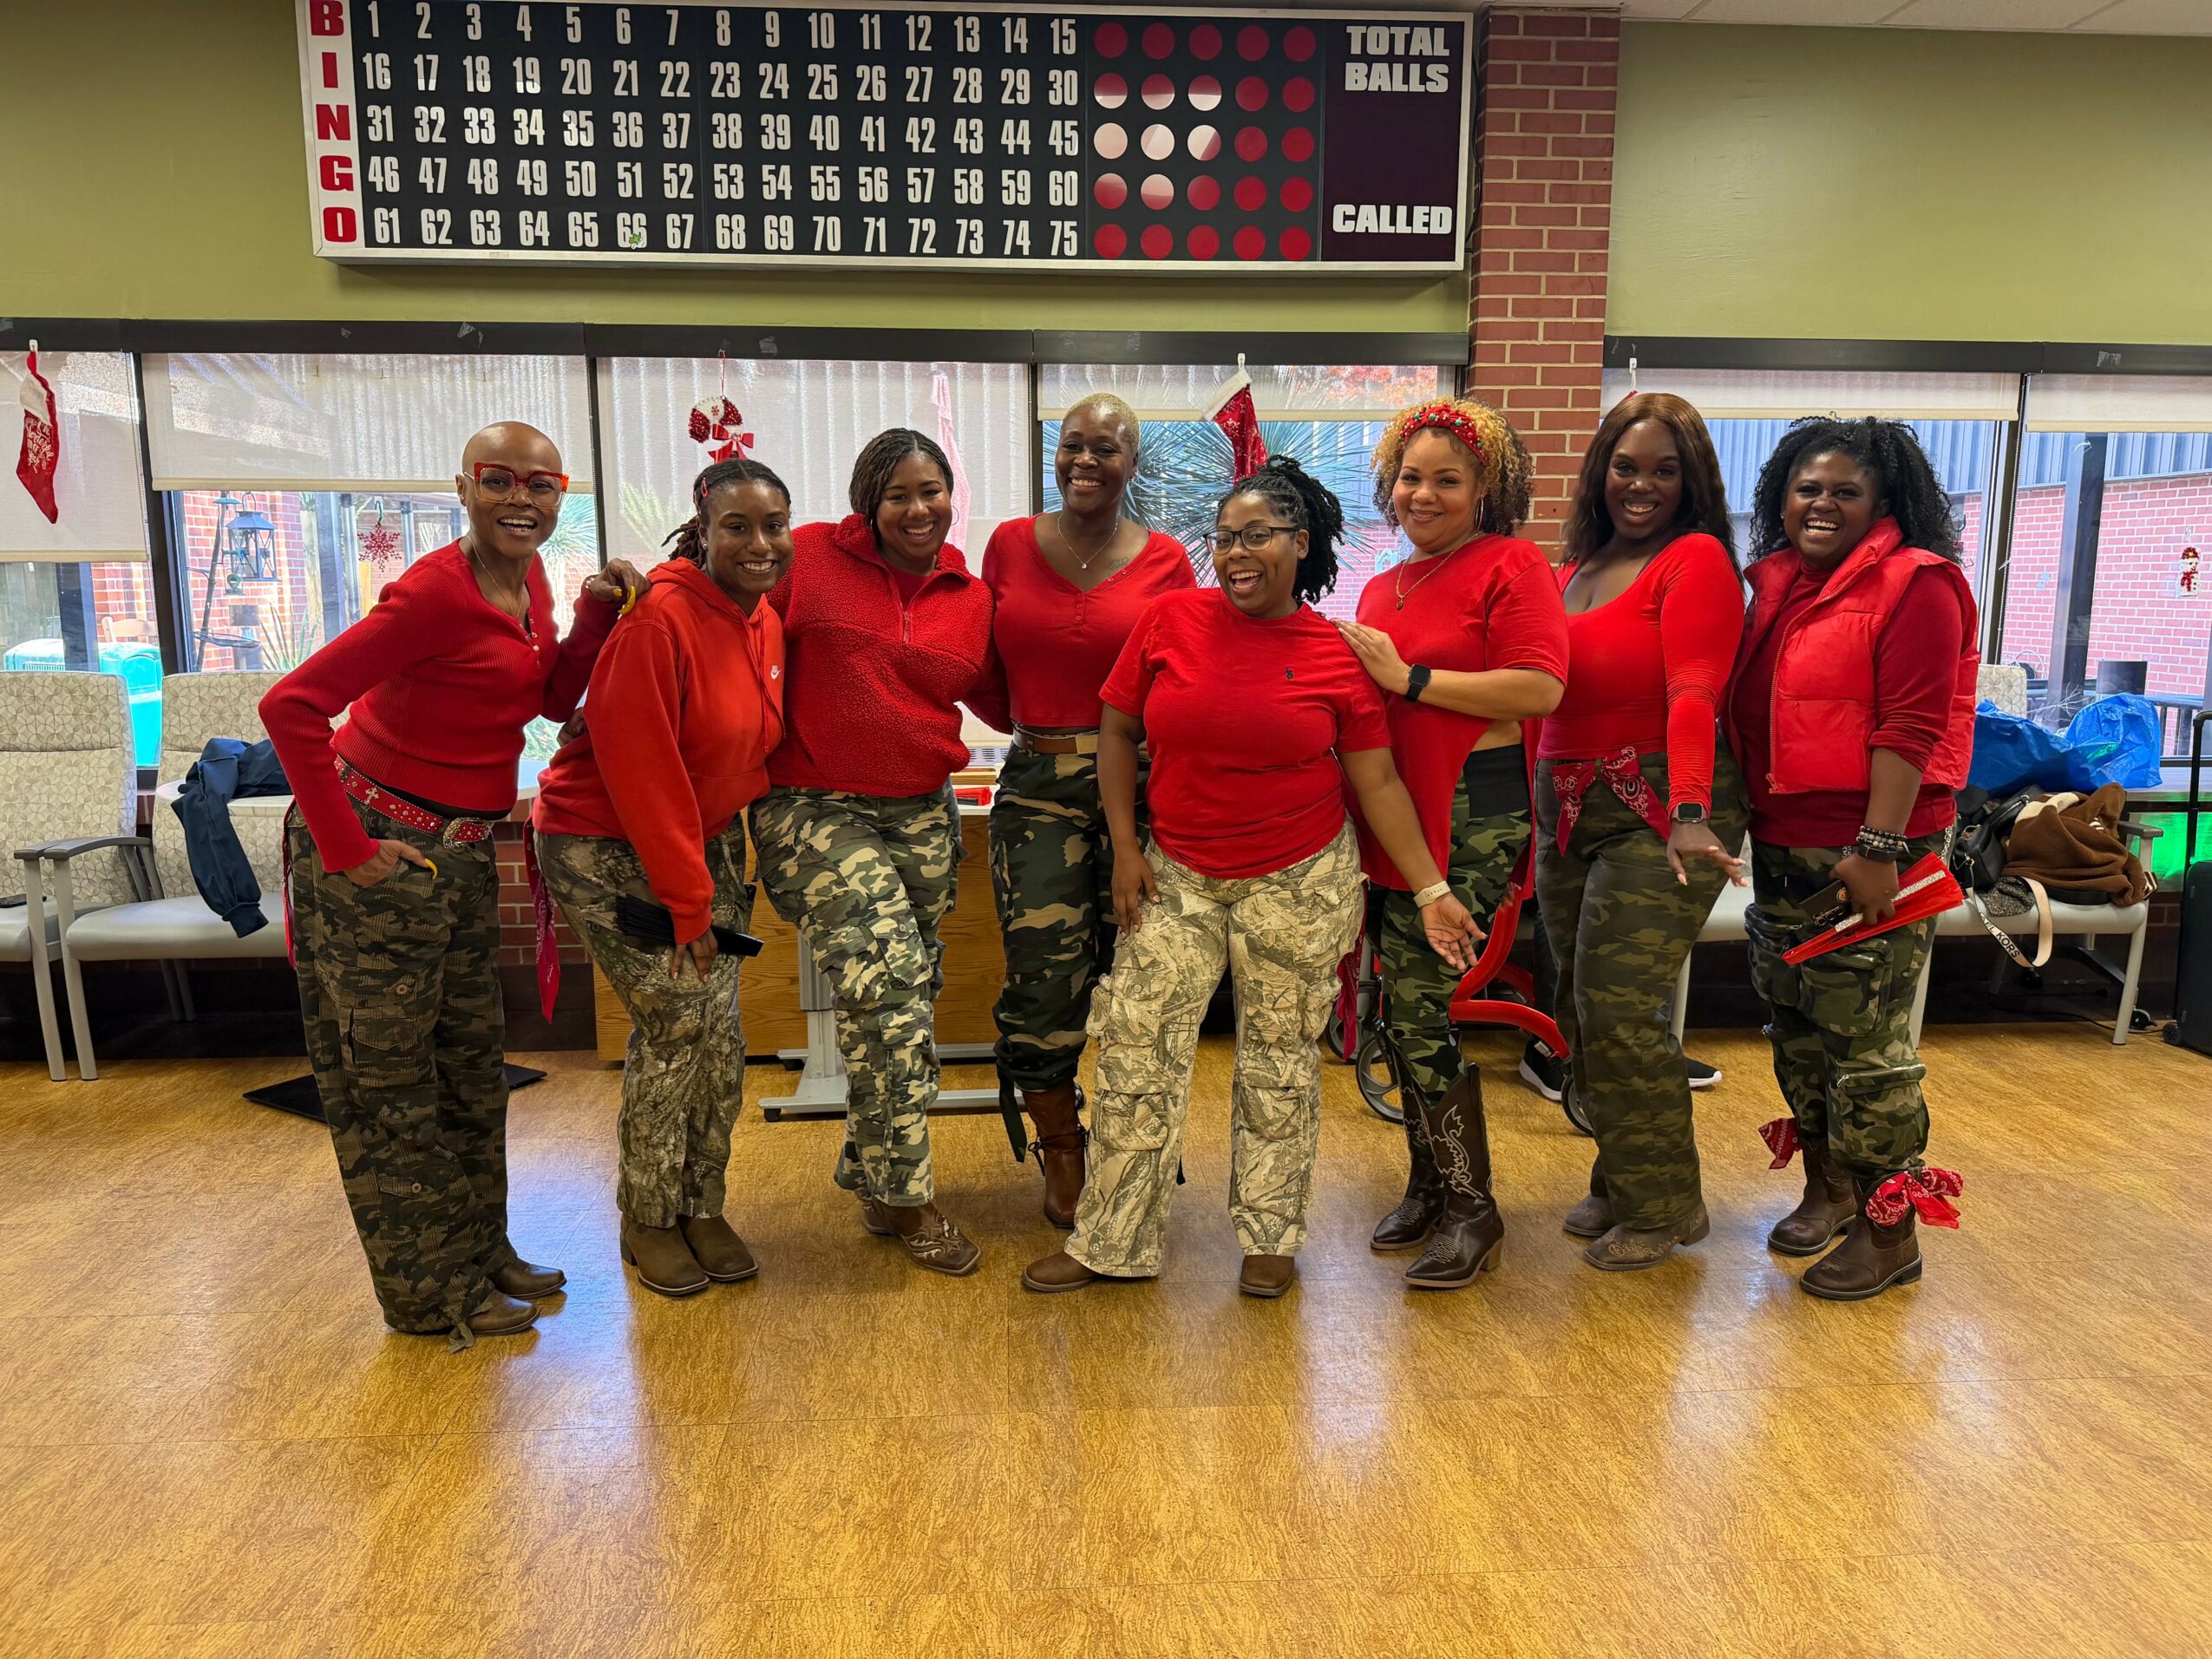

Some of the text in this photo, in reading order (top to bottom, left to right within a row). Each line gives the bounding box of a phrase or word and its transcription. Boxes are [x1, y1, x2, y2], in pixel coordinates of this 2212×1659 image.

[367, 0, 1077, 55] 1 2 3 4 5 6 7 8 9 10 11 12 13 14 15
[1345, 25, 1450, 56] TOTAL
[362, 52, 1078, 106] 16 17 18 19 20 21 22 23 24 25 26 27 28 29 30
[1345, 62, 1450, 93] BALLS
[366, 104, 1079, 156] 31 32 33 34 35 36 37 38 39 40 41 42 43 44 45
[368, 155, 1078, 206] 46 47 48 49 50 51 52 53 54 55 56 57 58 59 60
[373, 207, 1078, 257] 61 62 63 64 65 66 67 68 69 70 71 72 73 74 75
[1332, 204, 1453, 235] CALLED
[1996, 931, 2020, 957] KORS
